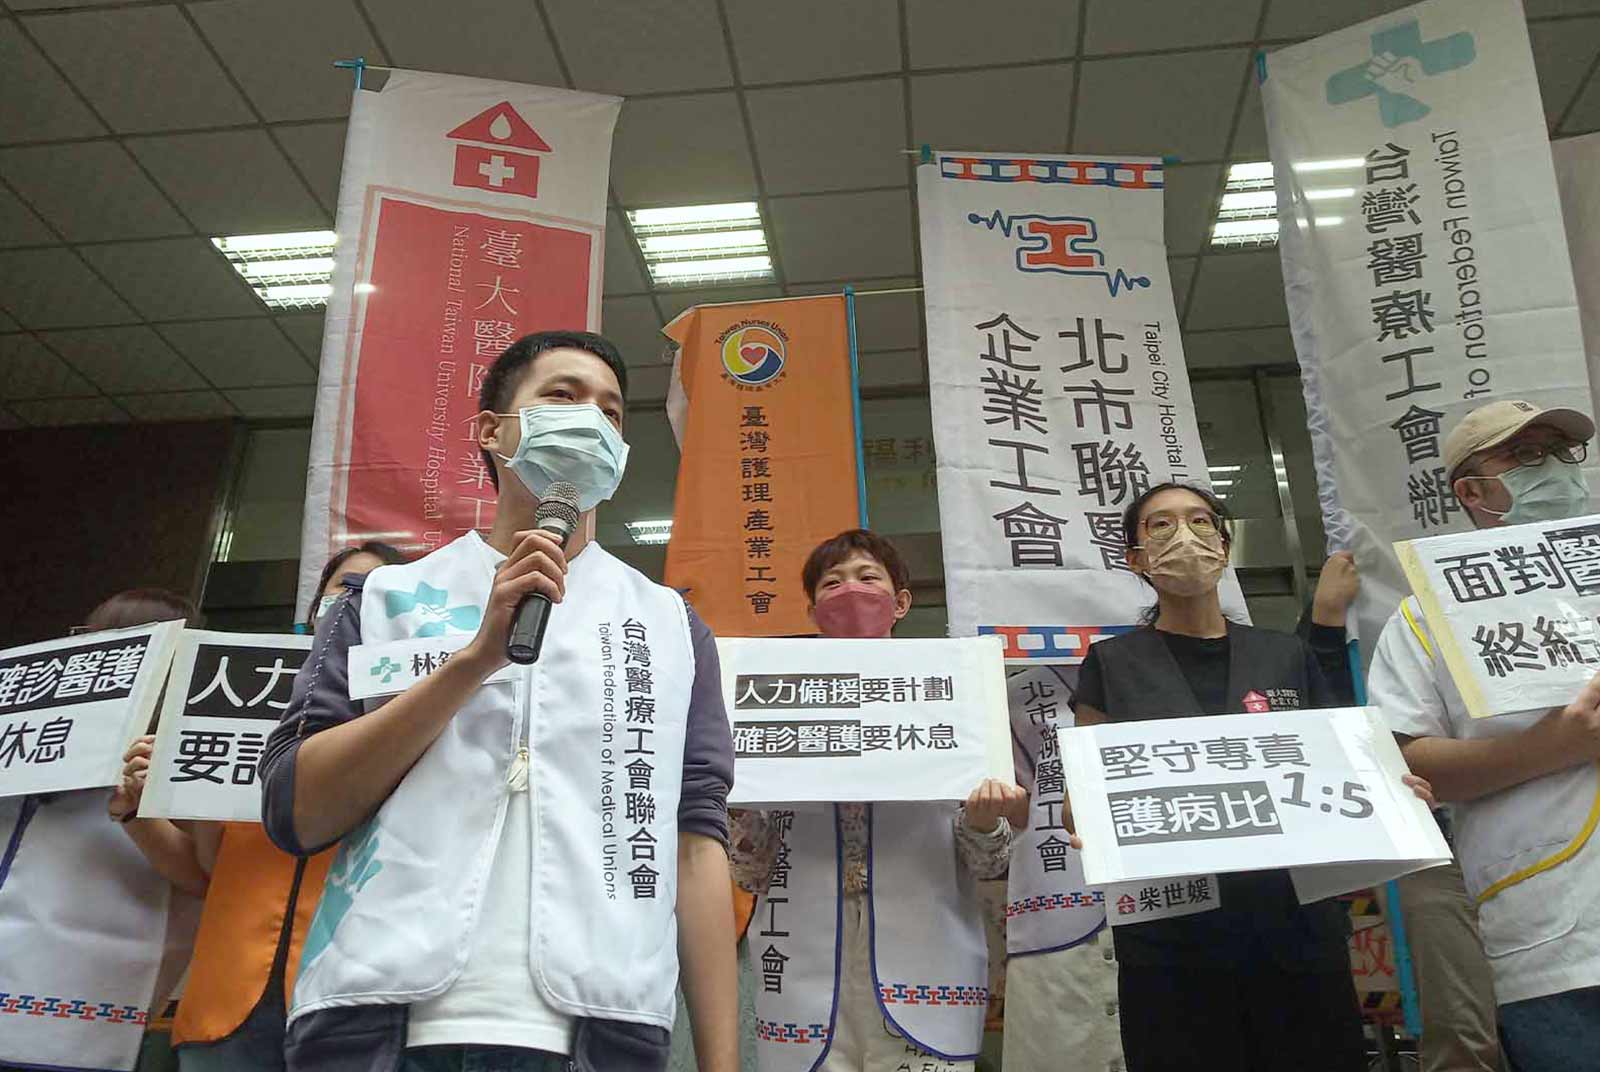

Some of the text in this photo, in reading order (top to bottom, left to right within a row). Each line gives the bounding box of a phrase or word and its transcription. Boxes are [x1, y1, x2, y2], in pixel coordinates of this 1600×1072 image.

[447, 223, 470, 293] National
[440, 299, 463, 354] Taiwan
[714, 321, 741, 344] Taiwan
[1143, 321, 1166, 366] Taipei
[426, 361, 457, 444] University
[1152, 370, 1169, 400] City
[974, 312, 1069, 569] 企業工會
[1158, 404, 1188, 468] Hospital
[420, 448, 446, 520] Hospital
[739, 405, 777, 615] 臺灣護理產業工會
[187, 656, 301, 708] 人力
[736, 675, 953, 706] 人力備援要計劃
[0, 716, 74, 768] 休息
[598, 621, 618, 901] Taiwan Federation of Medical Unions
[621, 617, 660, 900] 台灣醫療工會聯合會
[733, 722, 958, 754] 確診醫護要休息
[1100, 733, 1311, 781] 堅守專責
